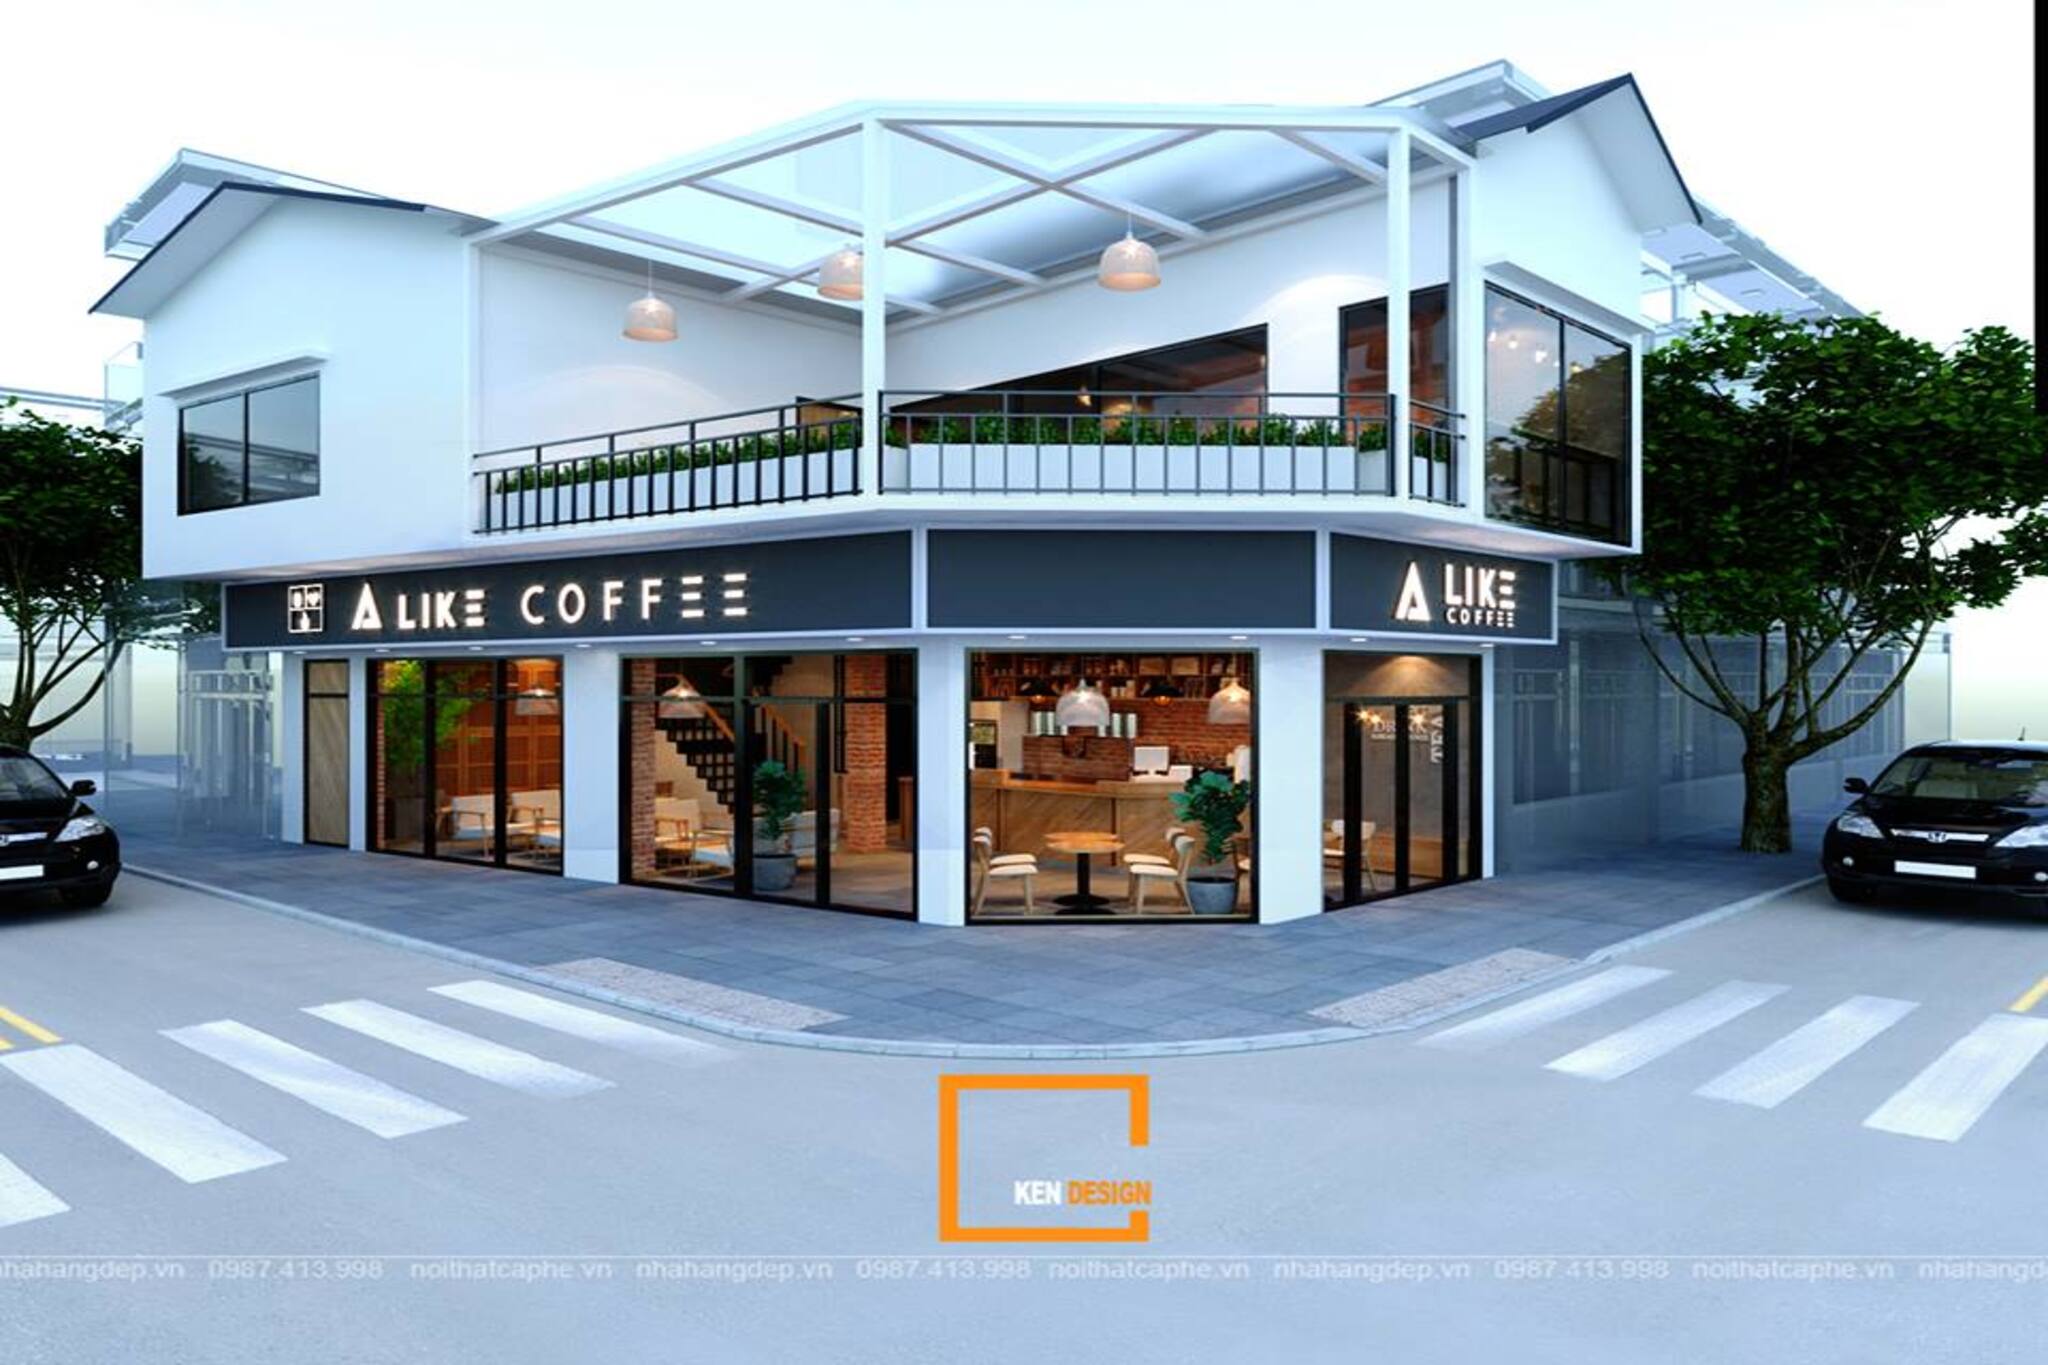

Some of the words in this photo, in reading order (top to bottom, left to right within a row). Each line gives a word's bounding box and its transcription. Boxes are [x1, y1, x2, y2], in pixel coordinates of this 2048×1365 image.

[351, 582, 383, 630] A
[398, 589, 486, 630] LIKE
[520, 573, 748, 626] COFFEE
[1394, 561, 1431, 622] A
[1445, 563, 1516, 609] LIKE
[1446, 608, 1515, 628] COFFEE
